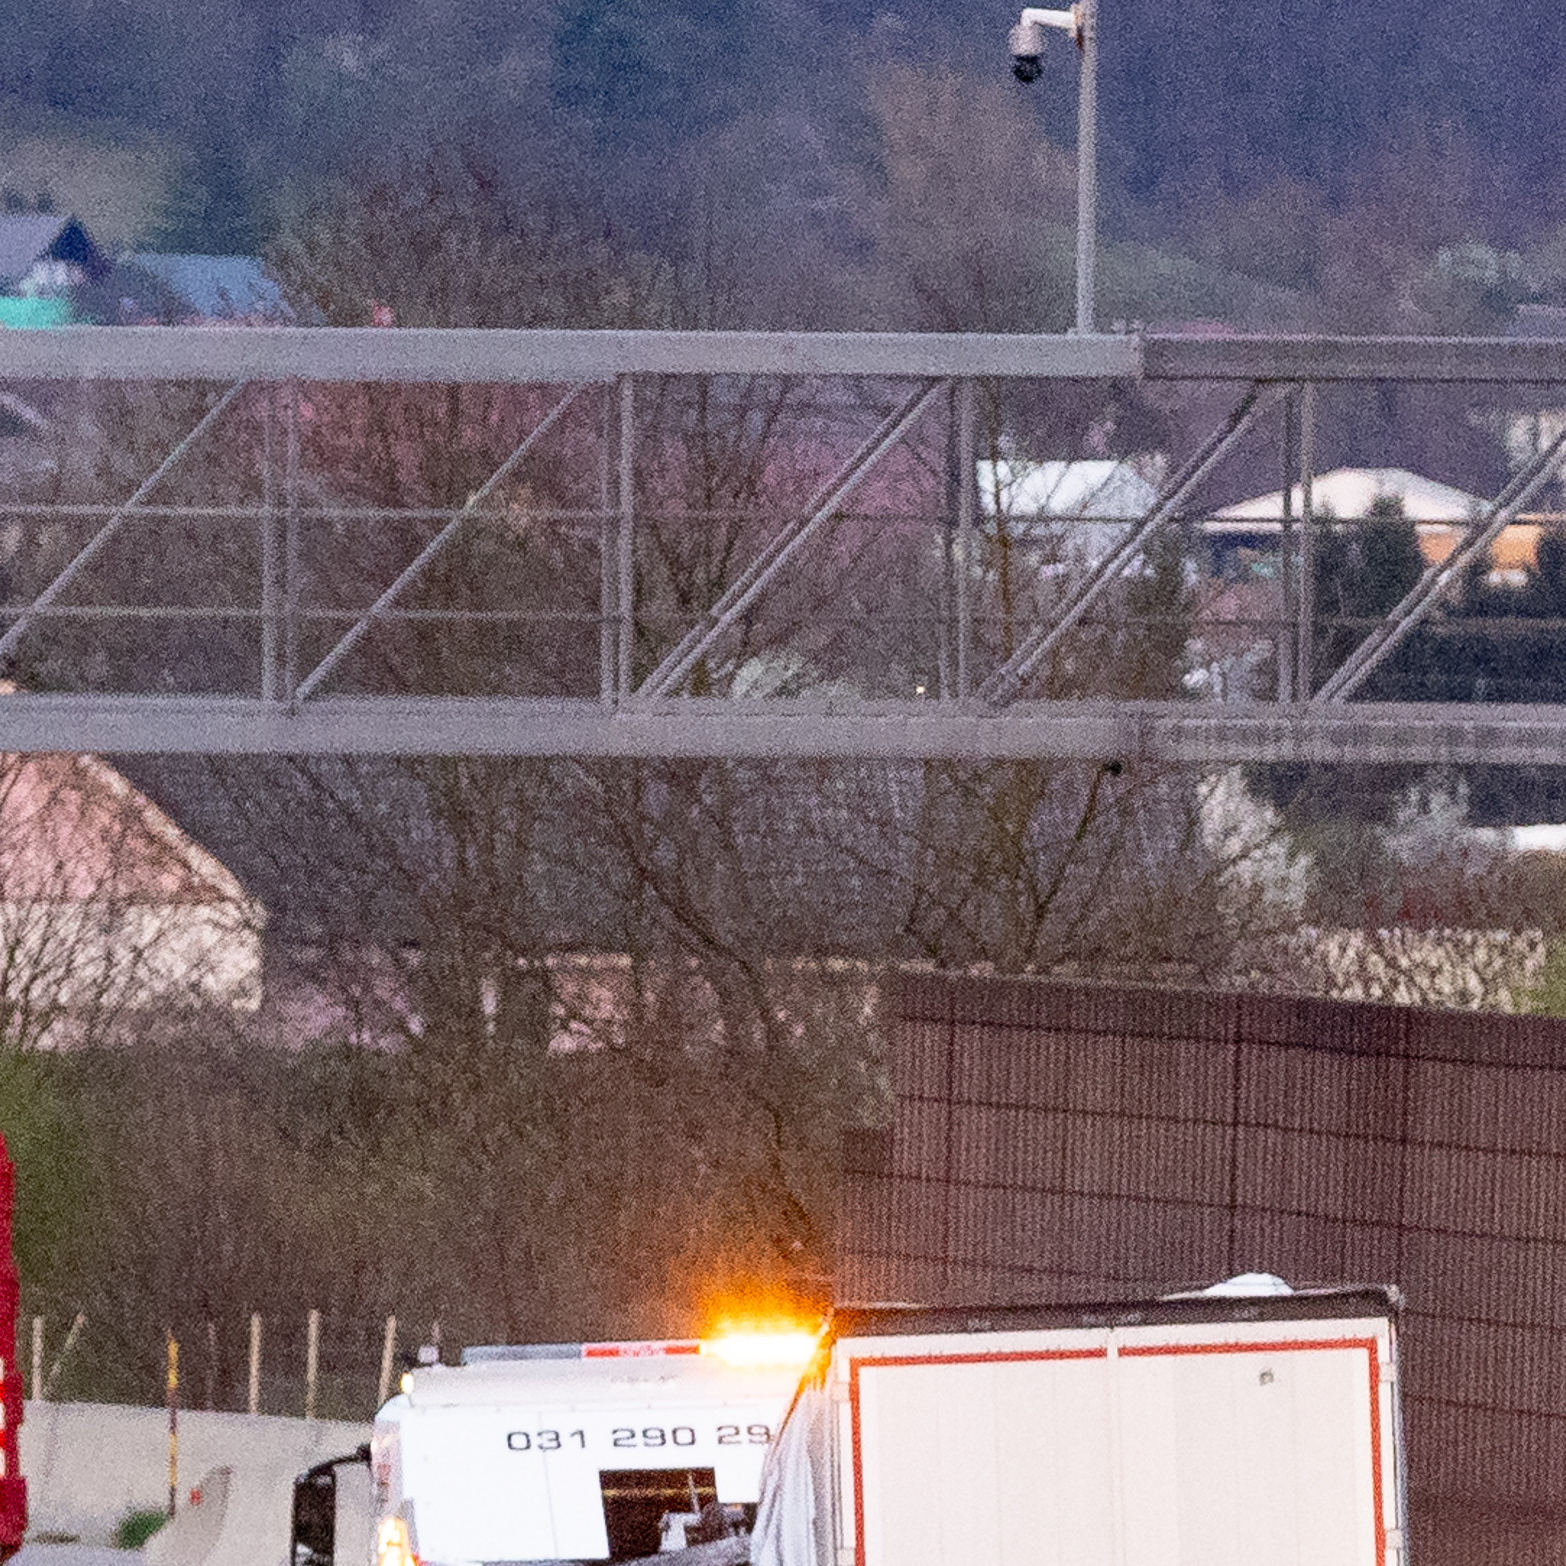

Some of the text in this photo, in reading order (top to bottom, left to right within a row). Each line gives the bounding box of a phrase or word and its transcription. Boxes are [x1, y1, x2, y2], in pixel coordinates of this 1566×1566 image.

[506, 1424, 771, 1451] 031 290 29
